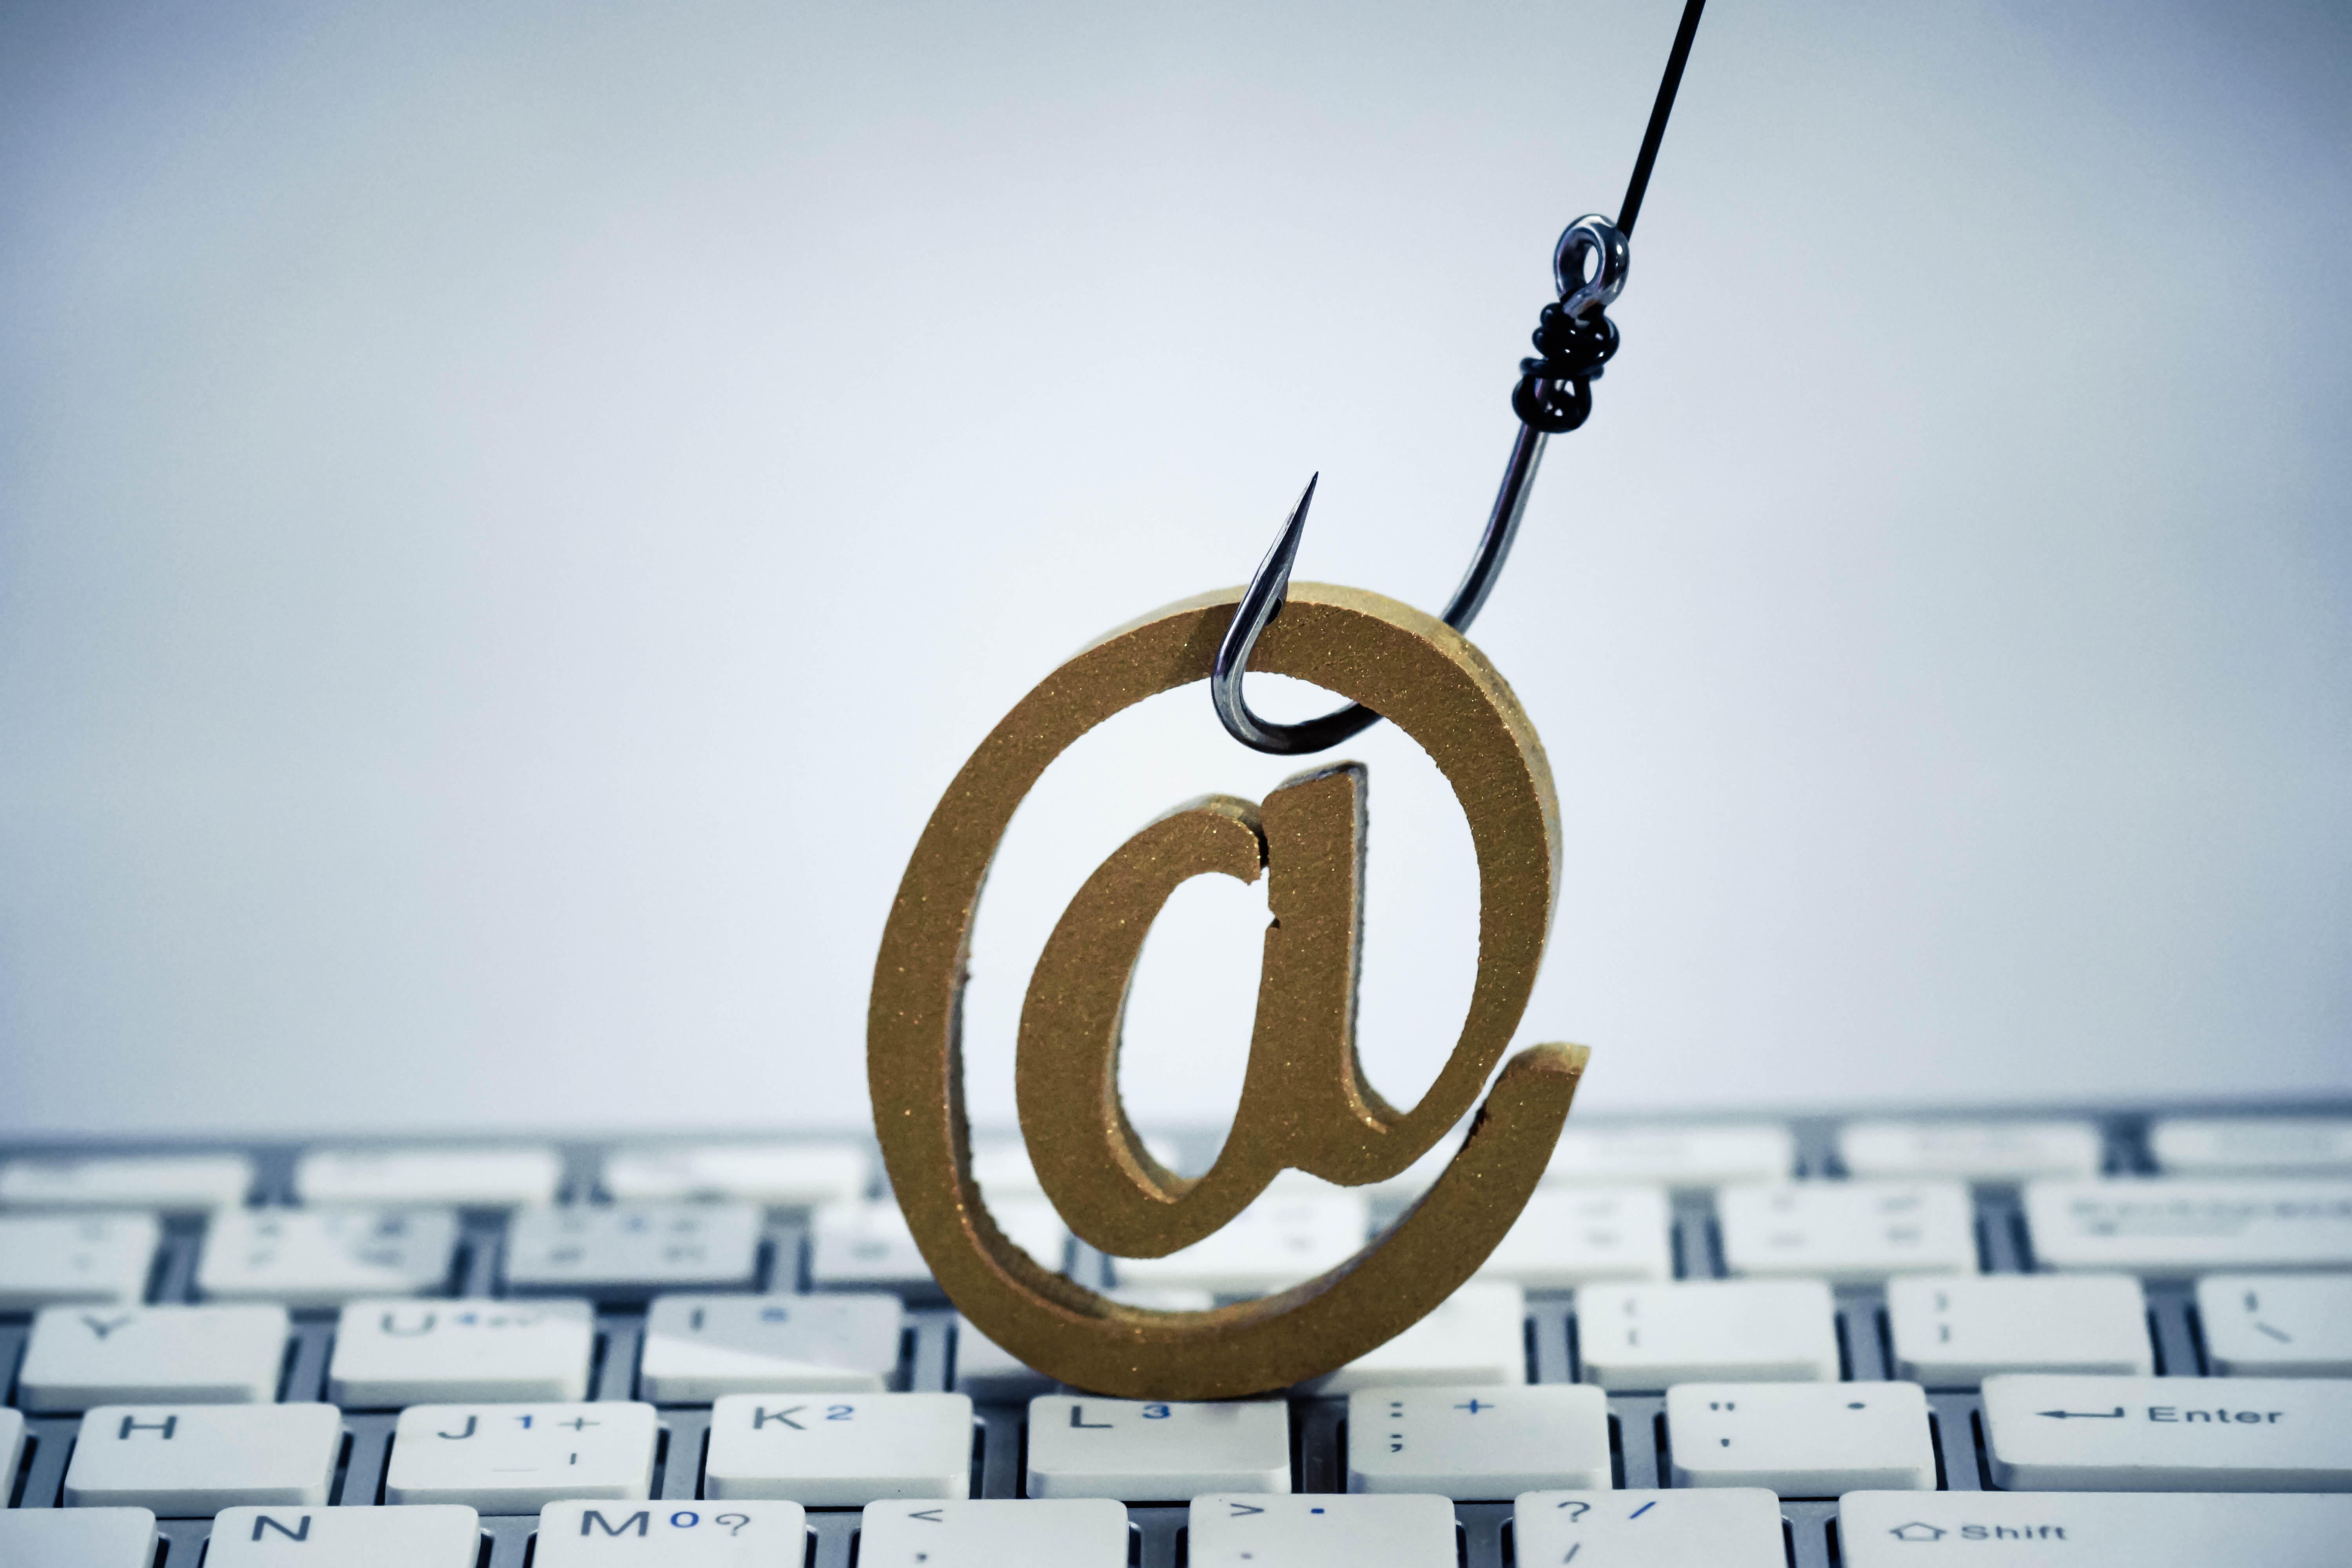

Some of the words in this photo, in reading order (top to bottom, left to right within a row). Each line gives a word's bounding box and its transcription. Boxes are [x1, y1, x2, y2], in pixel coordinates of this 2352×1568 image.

[867, 581, 1591, 1400] @
[80, 1315, 132, 1340] Y
[118, 1416, 177, 1440] H
[437, 1416, 477, 1439] J
[513, 1414, 533, 1430] 1
[753, 1407, 805, 1430] K
[826, 1405, 855, 1420] 2
[1070, 1405, 1112, 1428] L
[1142, 1404, 1171, 1419] 3
[2148, 1407, 2282, 1424] Enter
[581, 1510, 650, 1537] M
[1558, 1501, 1591, 1522] ?
[251, 1515, 311, 1542] N
[1962, 1526, 2065, 1540] Shift
